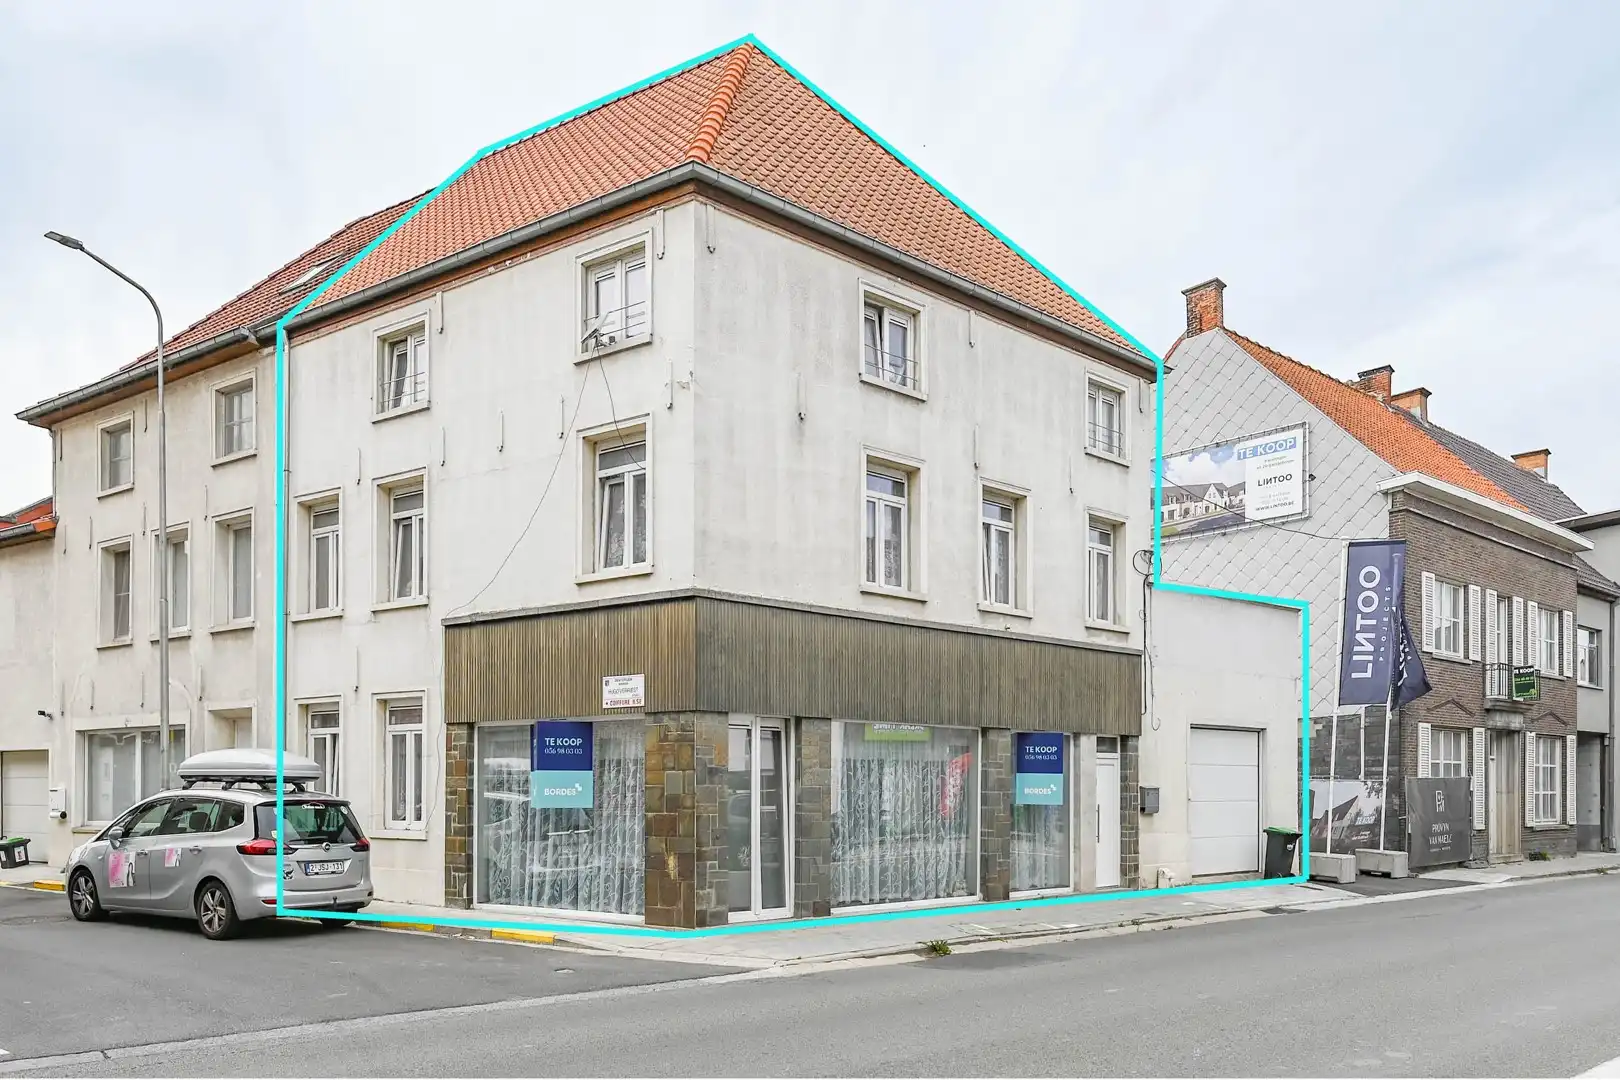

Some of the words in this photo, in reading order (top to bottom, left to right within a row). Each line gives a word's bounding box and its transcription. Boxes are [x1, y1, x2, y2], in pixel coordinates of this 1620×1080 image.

[1239, 447, 1253, 459] TE
[1257, 438, 1295, 455] KOOP
[1350, 565, 1381, 679] LINTOO
[1379, 586, 1391, 662] PROJECTS
[545, 738, 555, 746] TE
[556, 738, 583, 746] KOOP
[544, 788, 576, 796] BORDES
[1428, 836, 1437, 845] VAN
